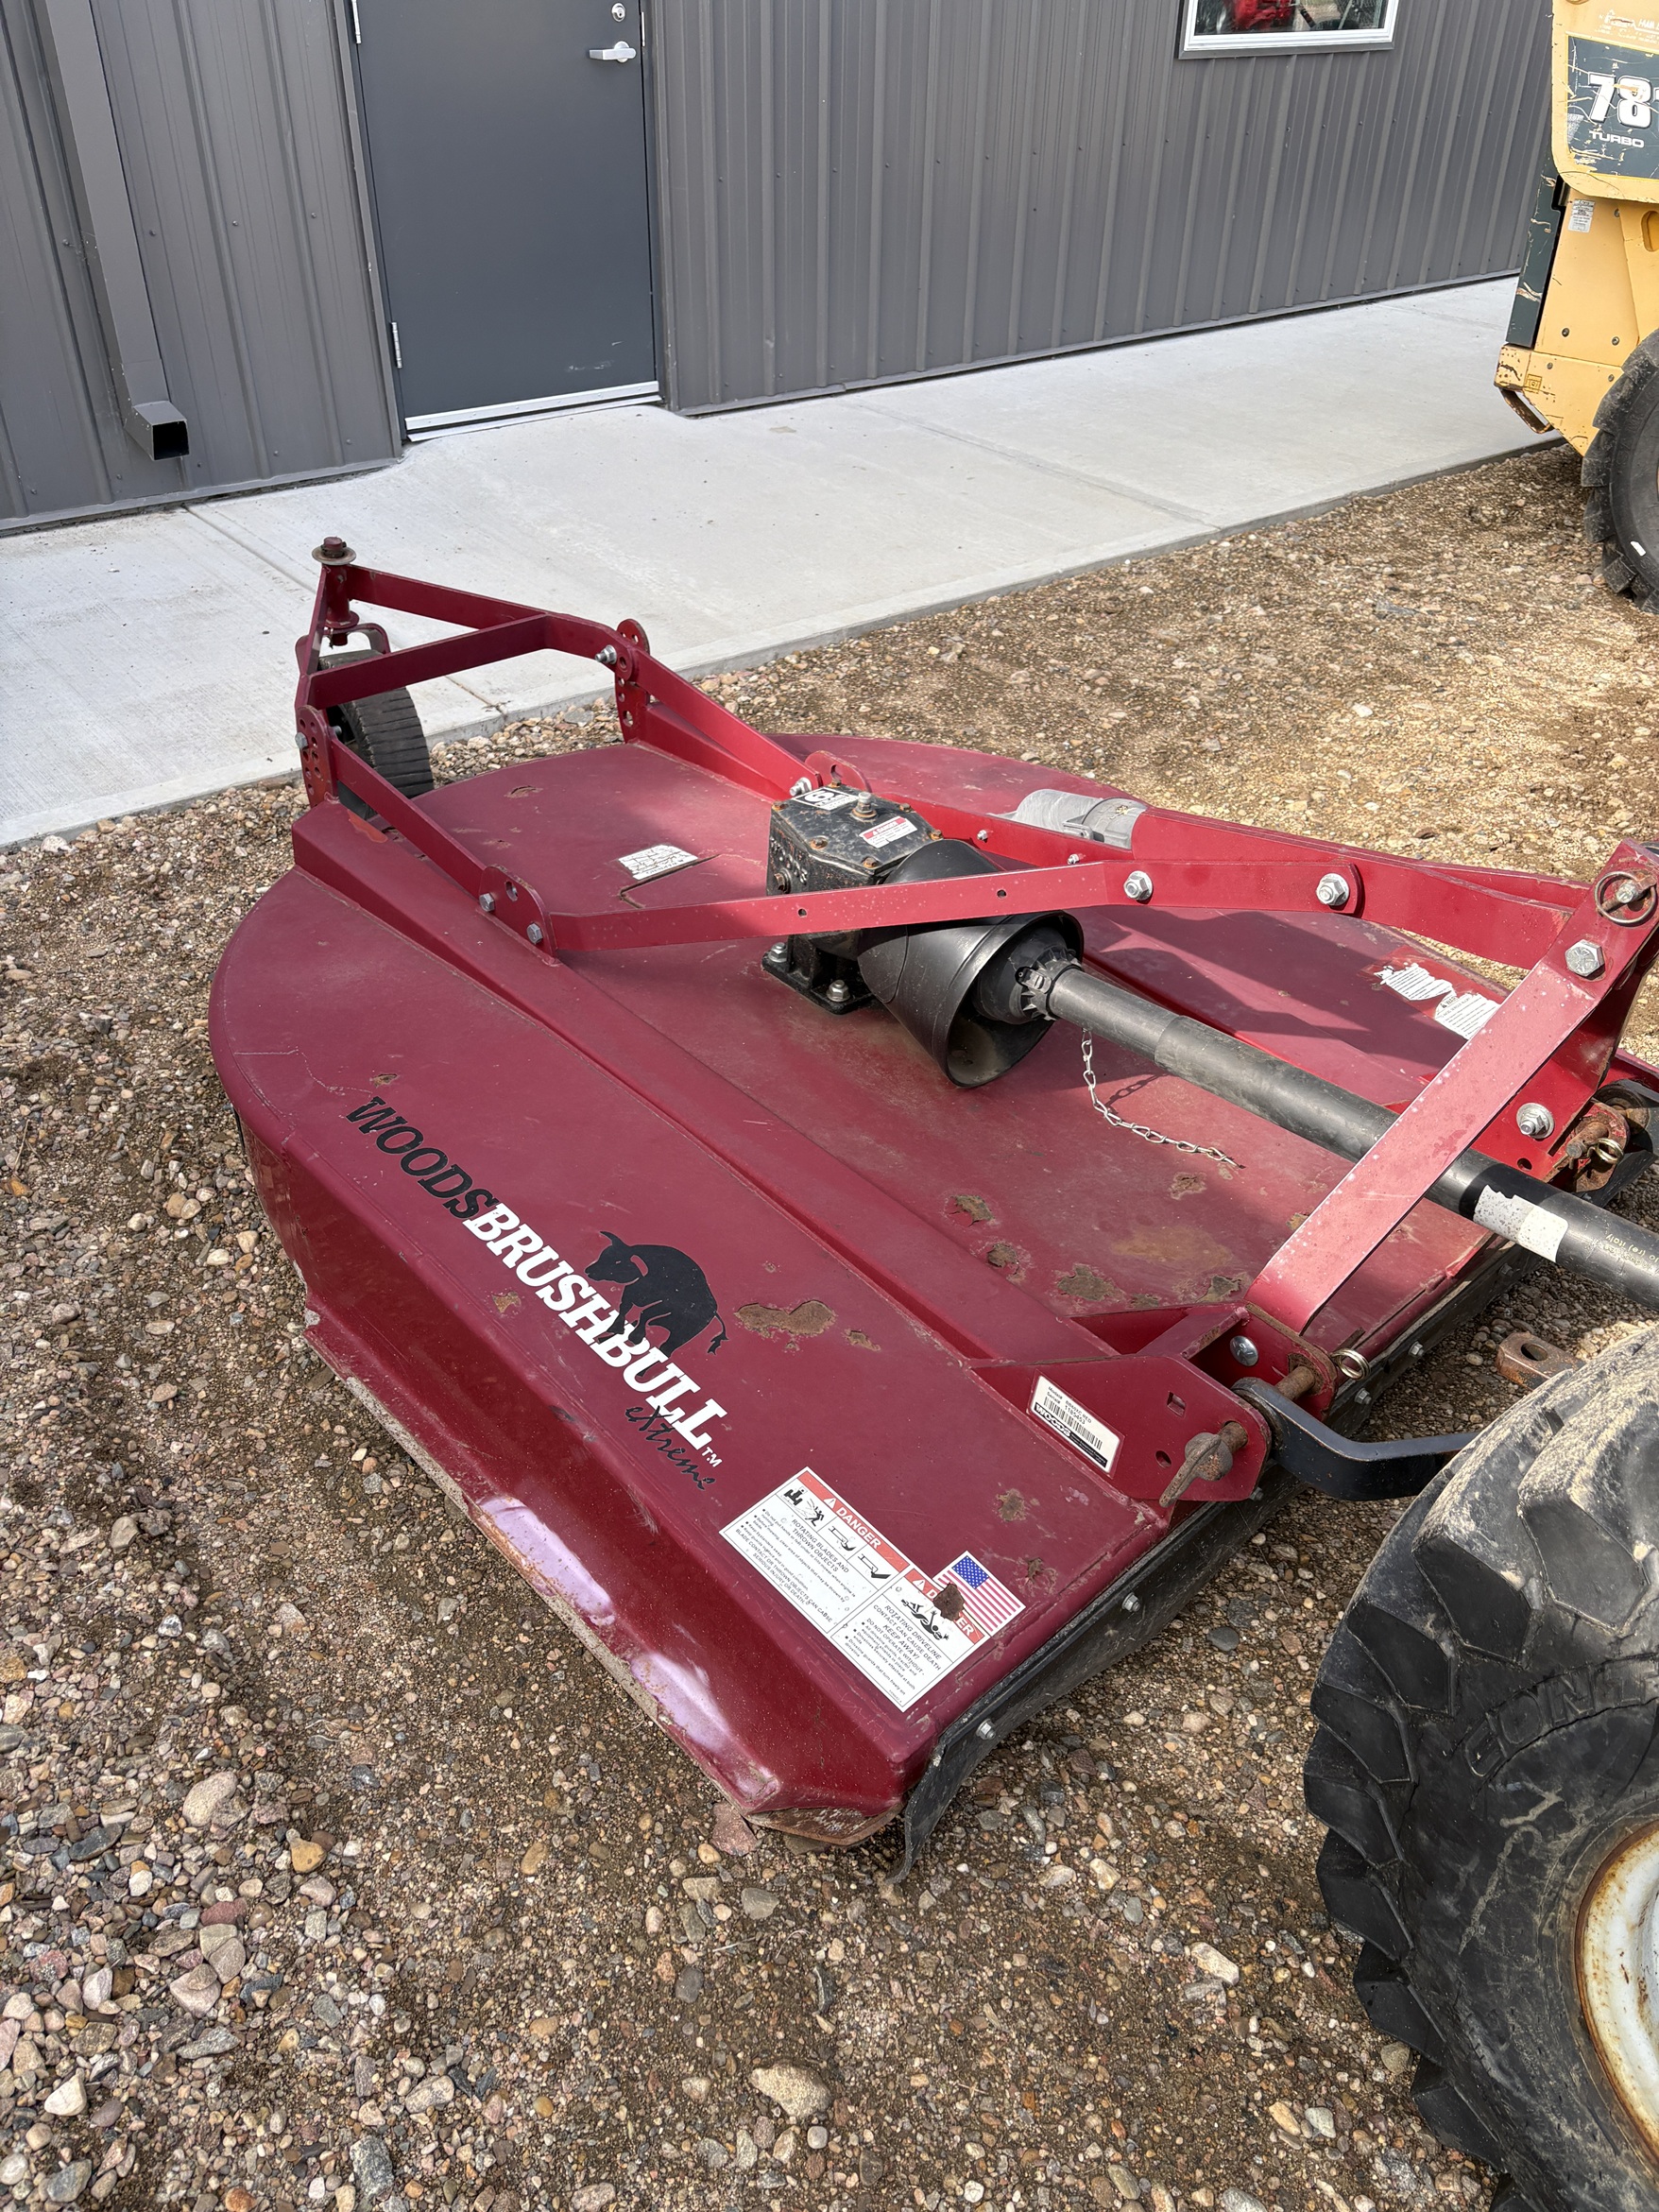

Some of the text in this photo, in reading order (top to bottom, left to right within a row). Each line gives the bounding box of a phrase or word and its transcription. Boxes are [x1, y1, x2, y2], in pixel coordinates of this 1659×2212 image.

[1587, 71, 1659, 129] 78
[1589, 130, 1645, 148] TURBO
[1605, 1233, 1626, 1248] italy
[346, 1096, 500, 1220] WOODS
[462, 1201, 727, 1449] BRUSHBULL
[755, 1531, 774, 1549] bystanders
[791, 1518, 849, 1573] ROTATING BLADES AND
[791, 1528, 839, 1571] THROWN OBJECTS
[835, 1506, 882, 1549] DANGER
[734, 1528, 749, 1542] BLADE
[747, 1540, 767, 1559] CONTACT
[772, 1564, 791, 1582] THROWN
[789, 1581, 809, 1600] OBJECTS
[807, 1598, 818, 1608] CAN
[750, 1535, 763, 1547] guards
[783, 1567, 794, 1576] good
[751, 1552, 771, 1570] SERIOUS
[769, 1569, 785, 1584] INJURY
[755, 1517, 768, 1528] Before
[778, 1538, 789, 1548] clear
[787, 1547, 795, 1555] area
[797, 1556, 812, 1569] objects
[809, 1568, 818, 1576] that
[815, 1574, 825, 1583] may
[828, 1586, 842, 1598] thrown
[779, 1525, 792, 1535] hands
[799, 1544, 812, 1554] under
[812, 1556, 822, 1565] into
[819, 1563, 832, 1574] mower
[830, 1573, 842, 1584] when
[839, 1582, 853, 1594] engine
[883, 1604, 942, 1660] ROTATING DRIVELINE
[923, 1588, 977, 1636] DER
[860, 1628, 880, 1646] equipment
[869, 1629, 885, 1644] driveline
[908, 1668, 916, 1676] and
[872, 1603, 941, 1671] CONTACT CAN CAUSE DEATH
[872, 1623, 883, 1634] NOT
[881, 1633, 904, 1654] OPERATE
[900, 1653, 923, 1672] WITHOUT
[881, 1623, 920, 1659] KEEP AWAY!
[847, 1638, 864, 1654] Driveline
[862, 1653, 876, 1666] guards
[874, 1665, 883, 1673] that
[881, 1672, 891, 1680] turn
[888, 1679, 900, 1690] freely
[886, 1662, 903, 1678] attached
[905, 1680, 915, 1689] both
[1464, 1655, 1659, 1777] CONT
